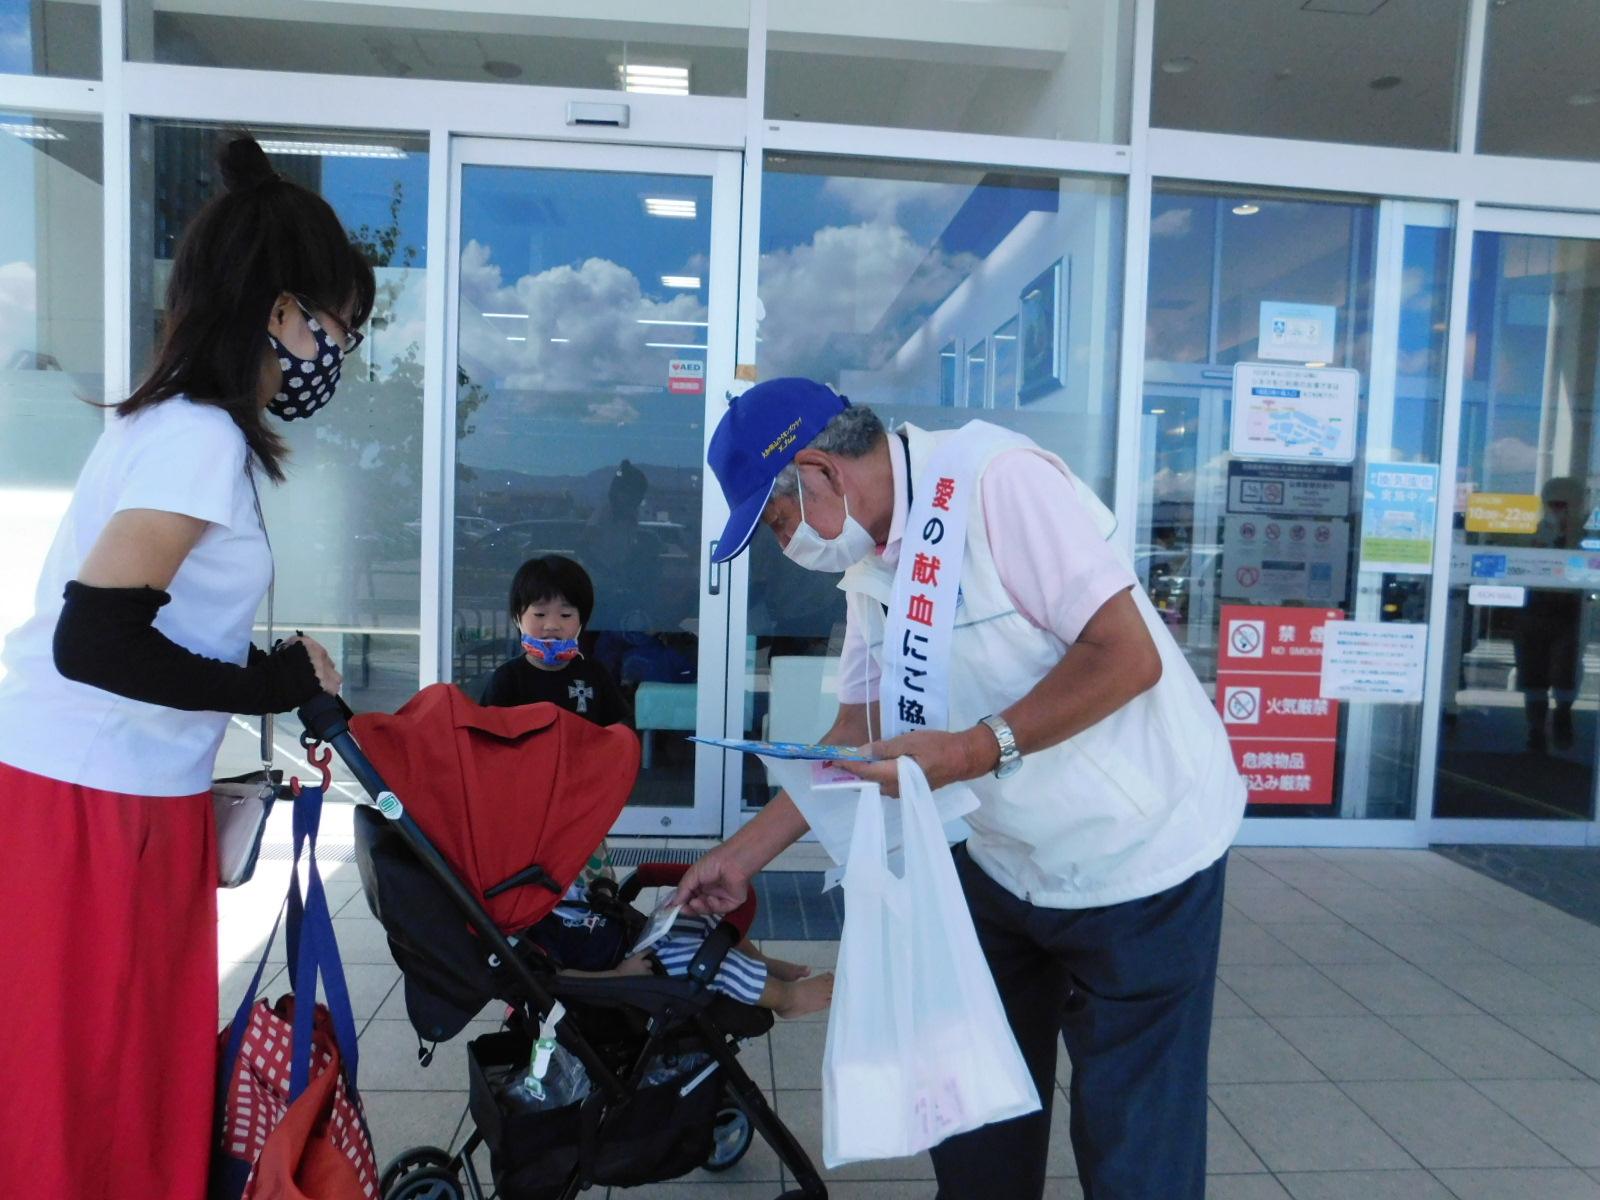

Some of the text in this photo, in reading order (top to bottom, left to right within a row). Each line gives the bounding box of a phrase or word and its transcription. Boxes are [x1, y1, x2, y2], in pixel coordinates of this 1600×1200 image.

[898, 477, 955, 733] 愛の献血にご協
[1266, 698, 1329, 716] 火気厳禁
[1242, 752, 1304, 769] 危険物品
